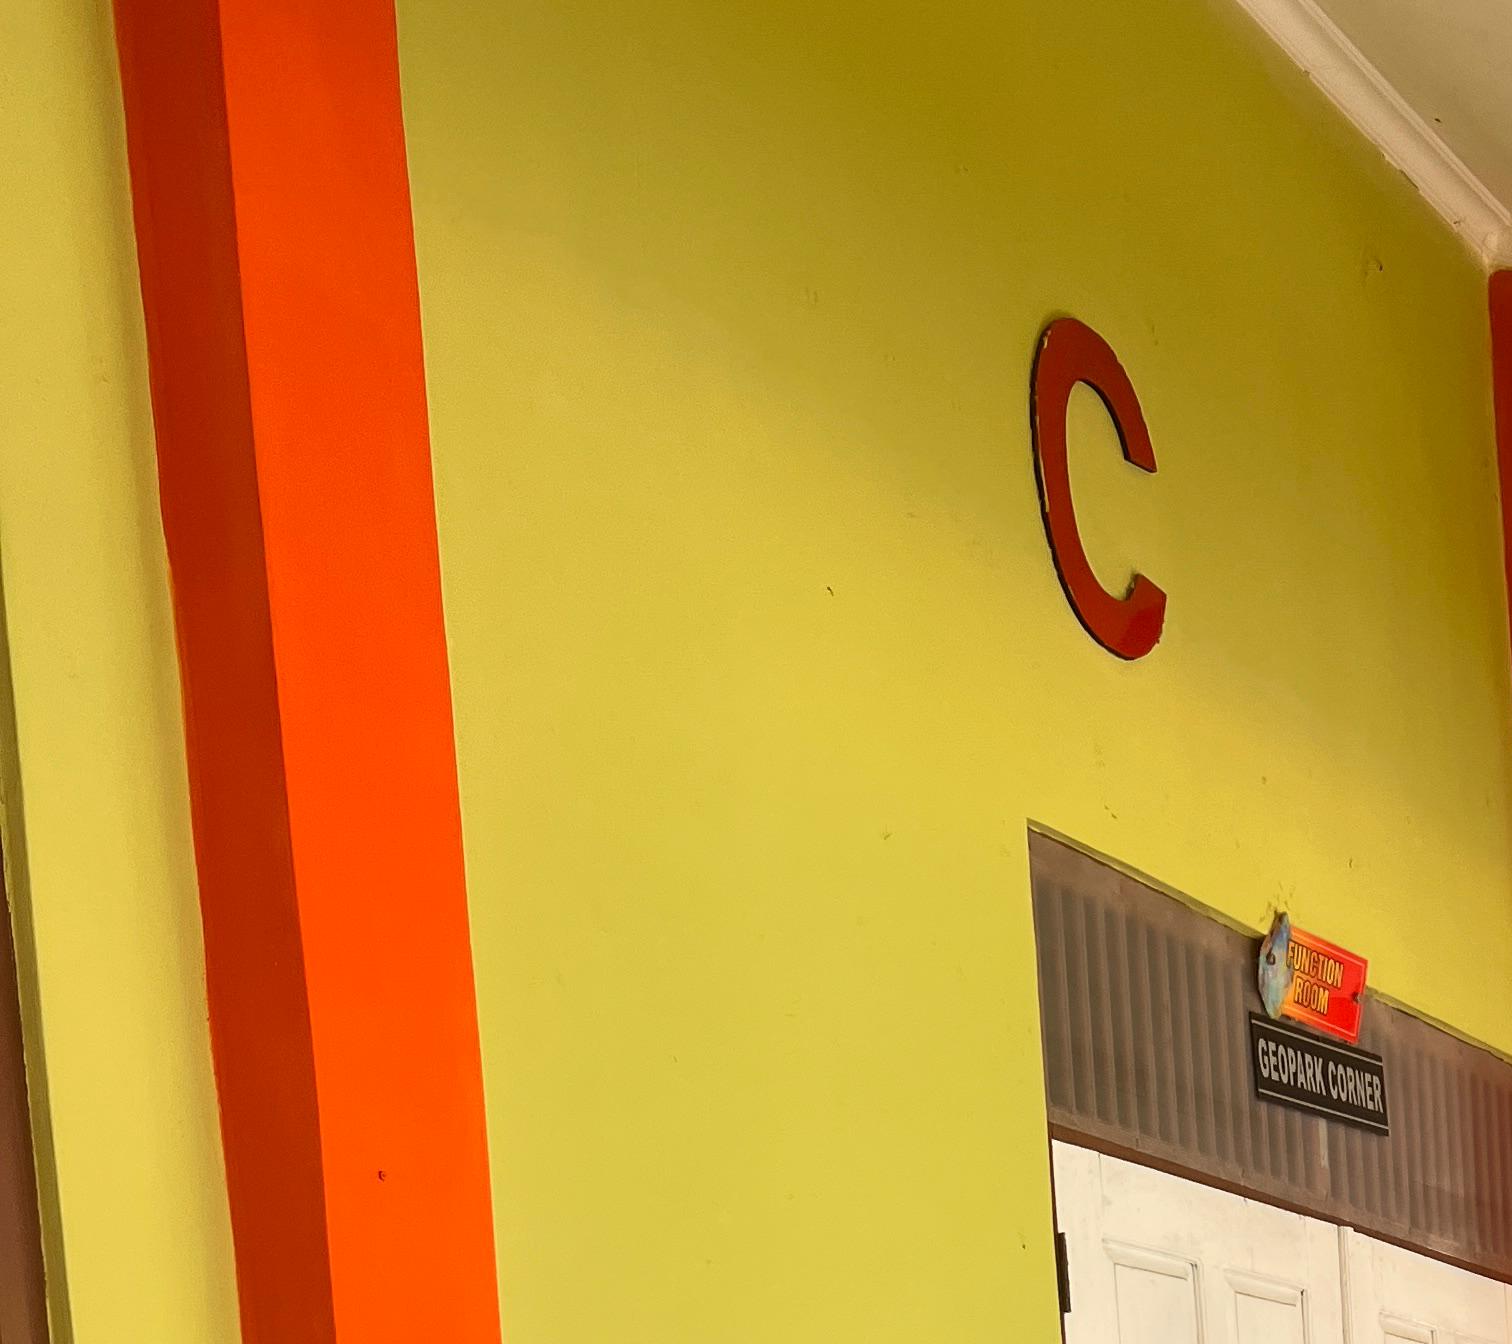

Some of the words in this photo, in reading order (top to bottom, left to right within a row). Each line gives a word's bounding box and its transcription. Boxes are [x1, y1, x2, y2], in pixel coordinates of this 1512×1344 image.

[1030, 317, 1167, 661] C
[1287, 939, 1344, 988] FUNCTION
[1294, 975, 1330, 1015] ROOM
[1257, 1037, 1327, 1096] GEOPARK
[1327, 1060, 1384, 1113] CORNER
